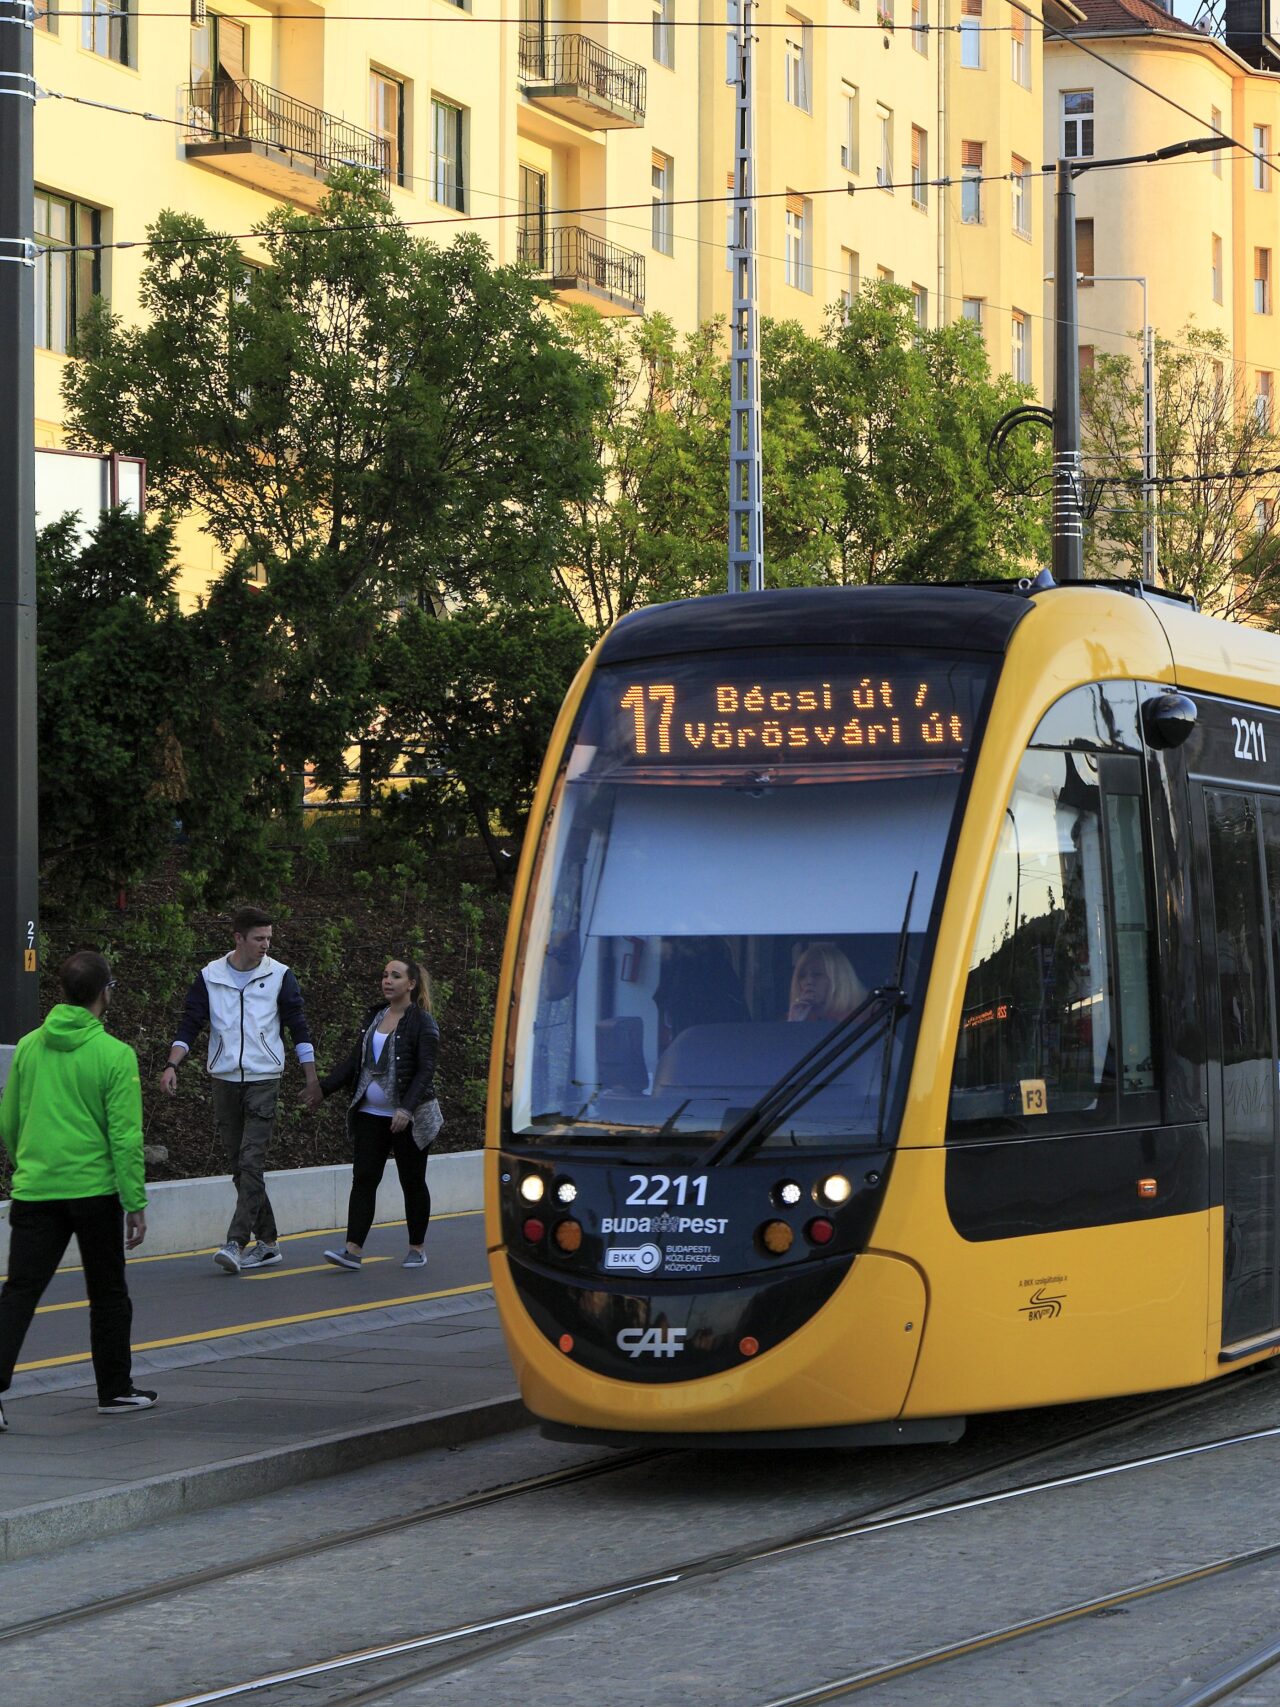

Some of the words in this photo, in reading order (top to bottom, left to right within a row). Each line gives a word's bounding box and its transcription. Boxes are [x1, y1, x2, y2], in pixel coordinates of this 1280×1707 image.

[715, 683, 832, 713] Bécsi
[852, 678, 894, 710] út
[914, 683, 928, 707] /
[619, 685, 675, 754] 17
[683, 717, 901, 749] Vörösvári
[921, 712, 963, 744] út
[1231, 716, 1267, 763] 2211
[1026, 1090, 1043, 1109] F3
[625, 1174, 708, 1206] 2211
[612, 1254, 636, 1263] BKK
[665, 1245, 711, 1253] BUDAPESTI
[616, 1327, 687, 1358] CAF
